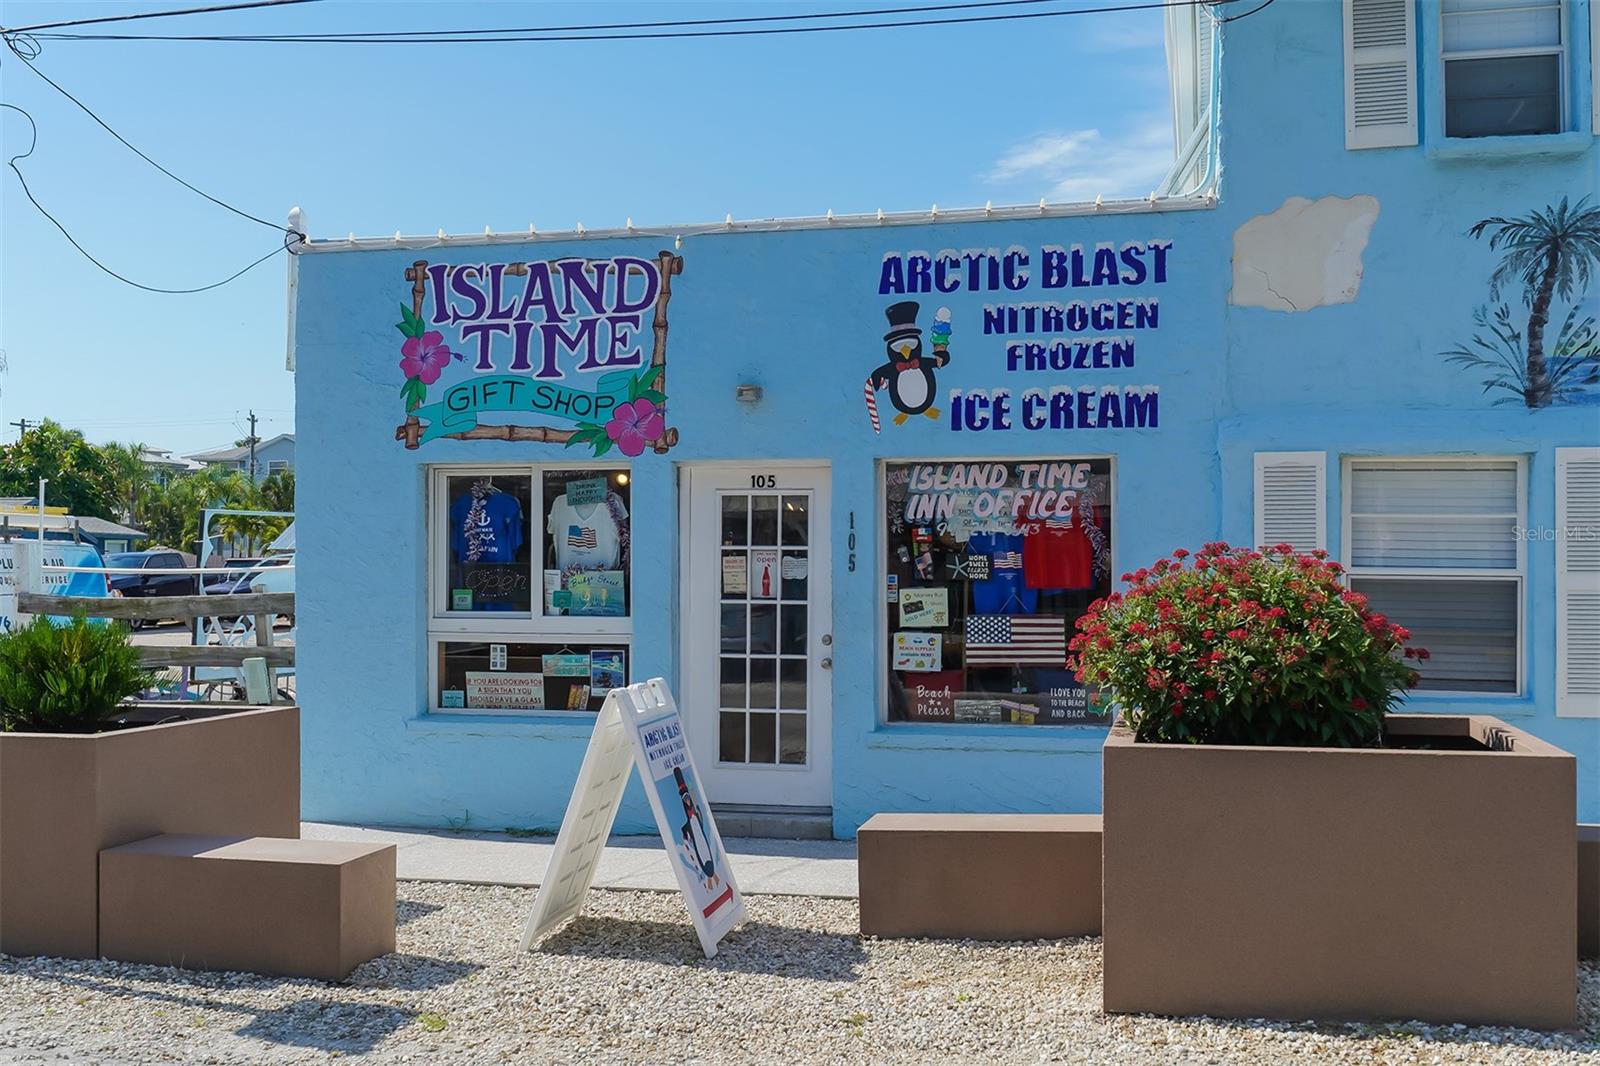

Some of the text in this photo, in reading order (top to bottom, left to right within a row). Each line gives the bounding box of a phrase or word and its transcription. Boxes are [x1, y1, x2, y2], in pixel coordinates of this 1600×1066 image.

[878, 239, 1174, 295] ARCTIC BLAST
[427, 257, 661, 327] ISLAND
[983, 297, 1160, 335] NITROGEN
[461, 315, 642, 379] TIME
[1006, 336, 1135, 372] FROZEN
[447, 381, 616, 419] GIFT SHOP
[950, 385, 1160, 431] ICE CREAM
[751, 475, 776, 488] 105
[909, 463, 1092, 491] ISLAND TIME
[907, 493, 956, 522] INN
[973, 490, 1077, 522] OFFICE
[848, 512, 856, 572] 105
[500, 678, 529, 686] LOOKING
[518, 687, 532, 695] YOU
[916, 684, 951, 700] Beach
[1054, 688, 1071, 697] LOVE
[1072, 688, 1086, 698] YOU
[917, 703, 951, 716] Please
[1051, 709, 1086, 719] AND BACK
[1067, 699, 1086, 707] BEACH
